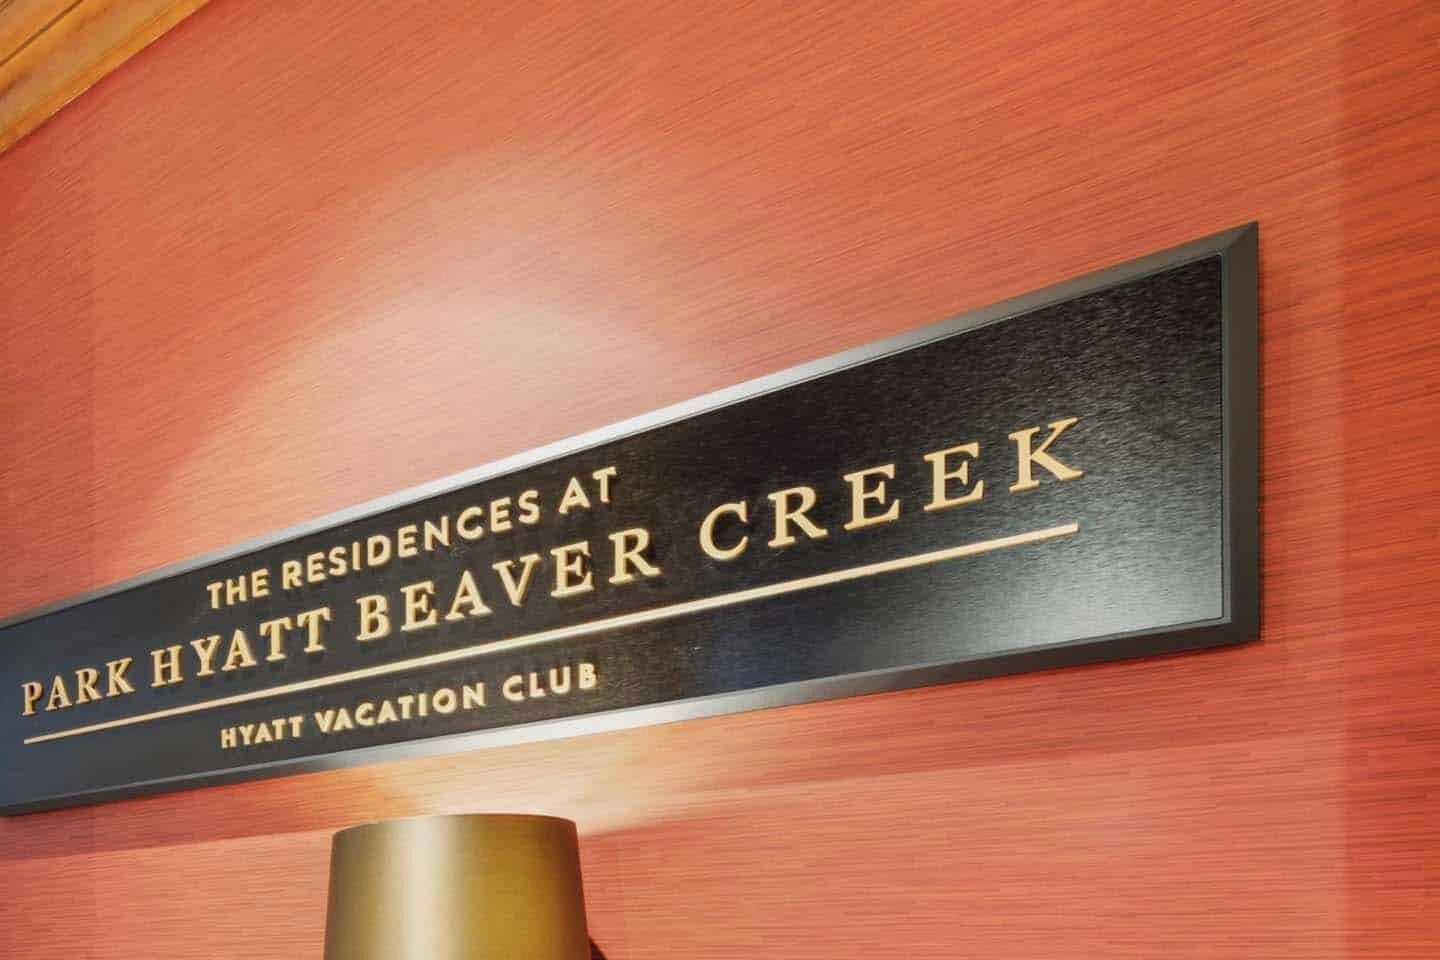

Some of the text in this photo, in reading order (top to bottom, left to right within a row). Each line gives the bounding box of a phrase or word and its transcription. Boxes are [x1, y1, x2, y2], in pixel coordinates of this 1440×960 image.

[22, 417, 1084, 716] PARK HYATT BEAVER CREEK
[207, 466, 619, 609] THE RESIDENCES AT
[221, 662, 599, 749] HYATT VACATION CLUB
